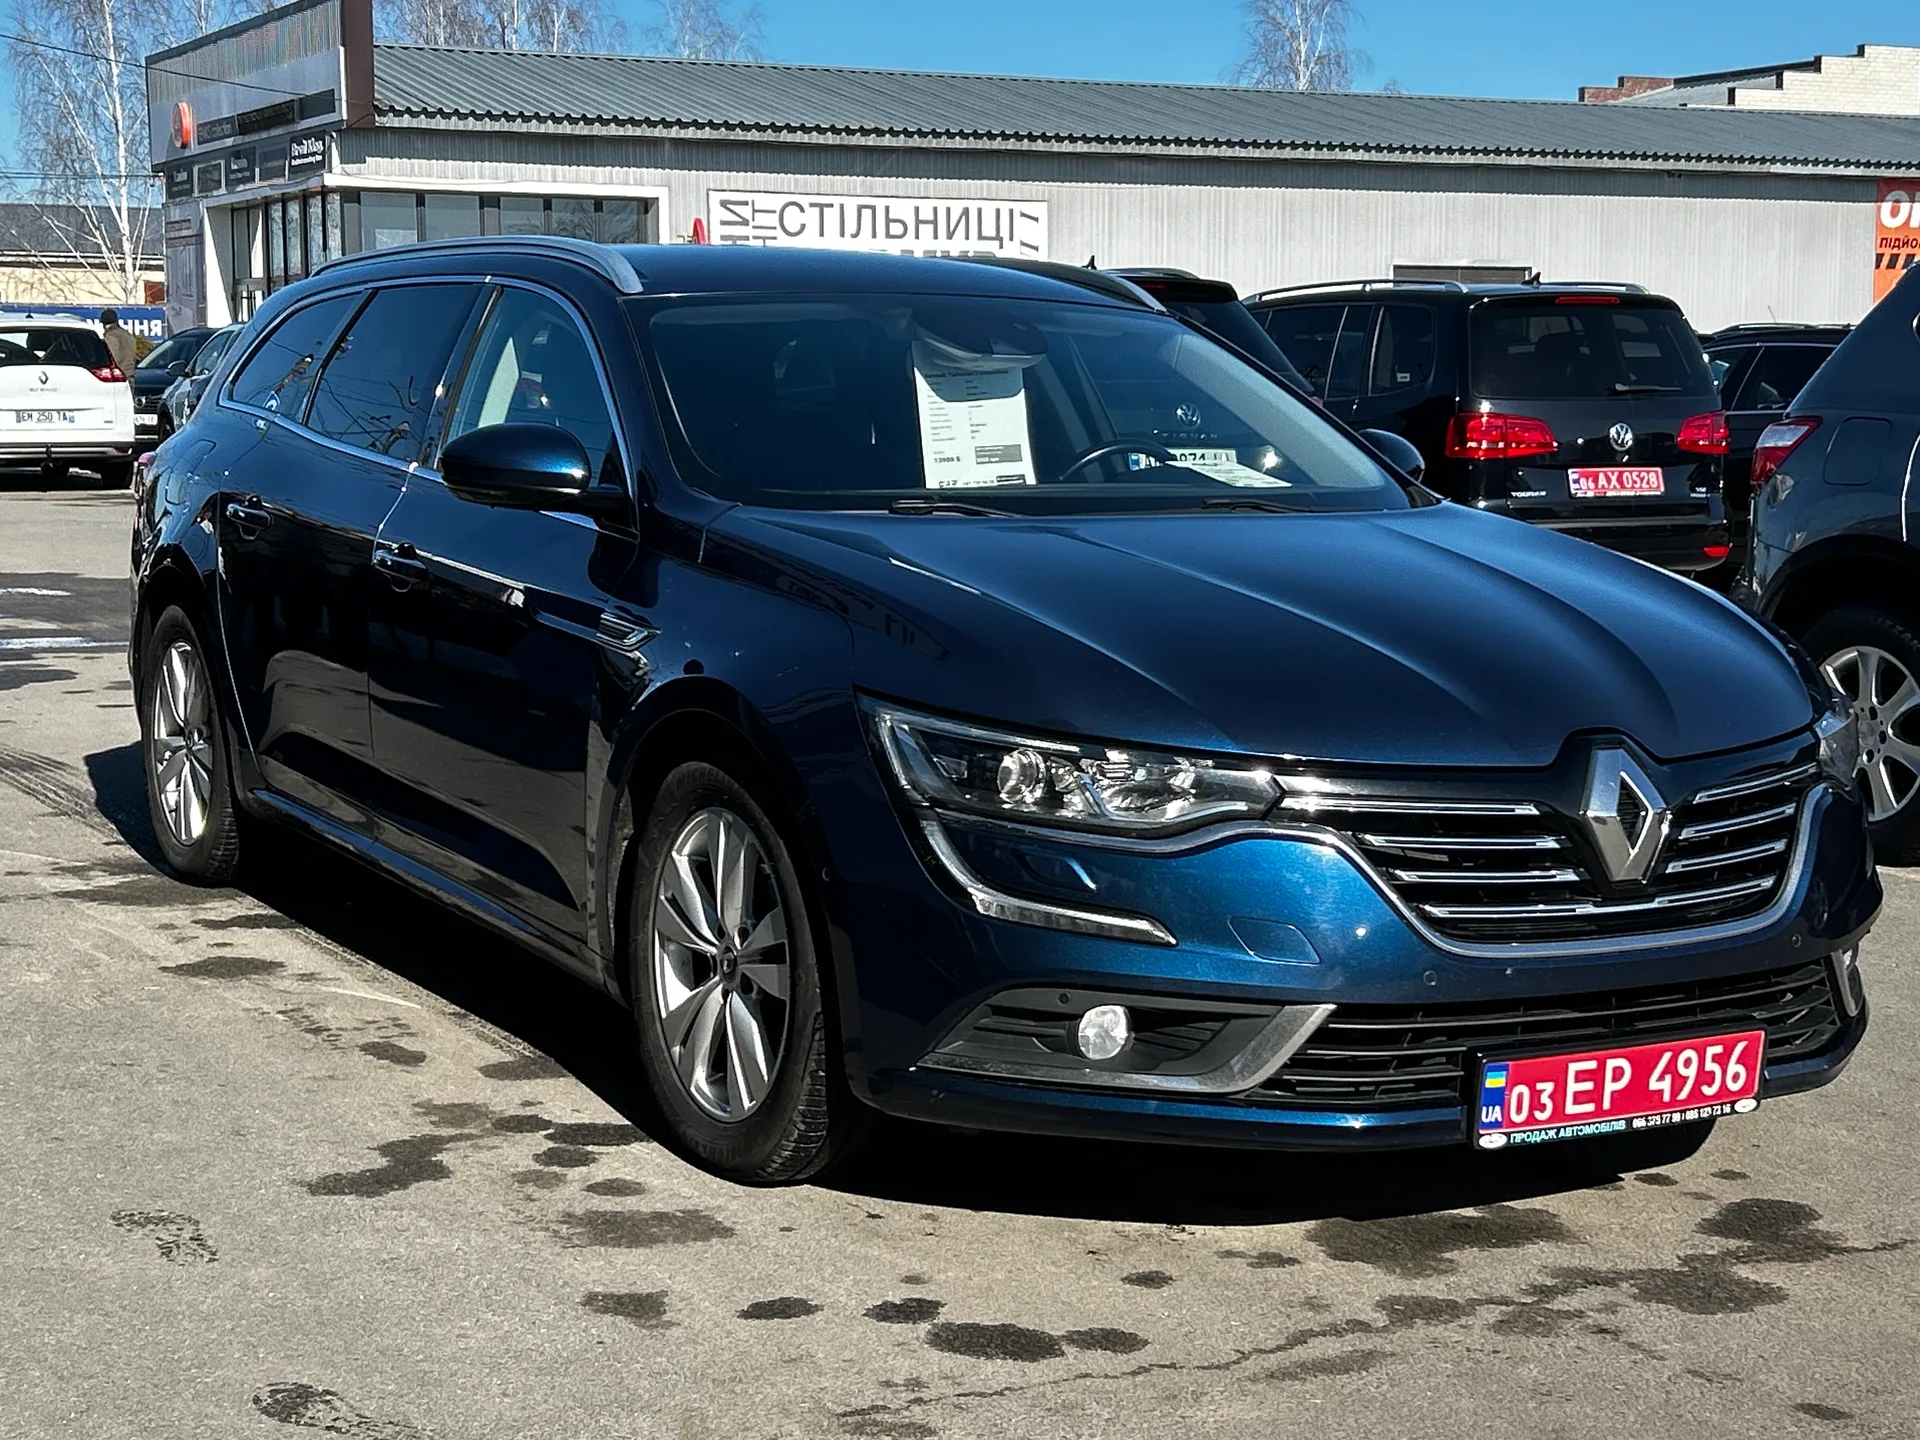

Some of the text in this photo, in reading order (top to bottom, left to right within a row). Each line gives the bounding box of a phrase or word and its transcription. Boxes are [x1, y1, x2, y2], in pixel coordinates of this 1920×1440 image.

[778, 201, 1014, 249] СТІЛЬНИЦІ
[1880, 235, 1920, 250] ПІДЙО
[1580, 471, 1658, 490] 06 AX 0528
[1509, 1041, 1749, 1124] 03 EP 4956
[1481, 1105, 1503, 1123] UA
[1510, 1129, 1557, 1143] ПРОДАЖ
